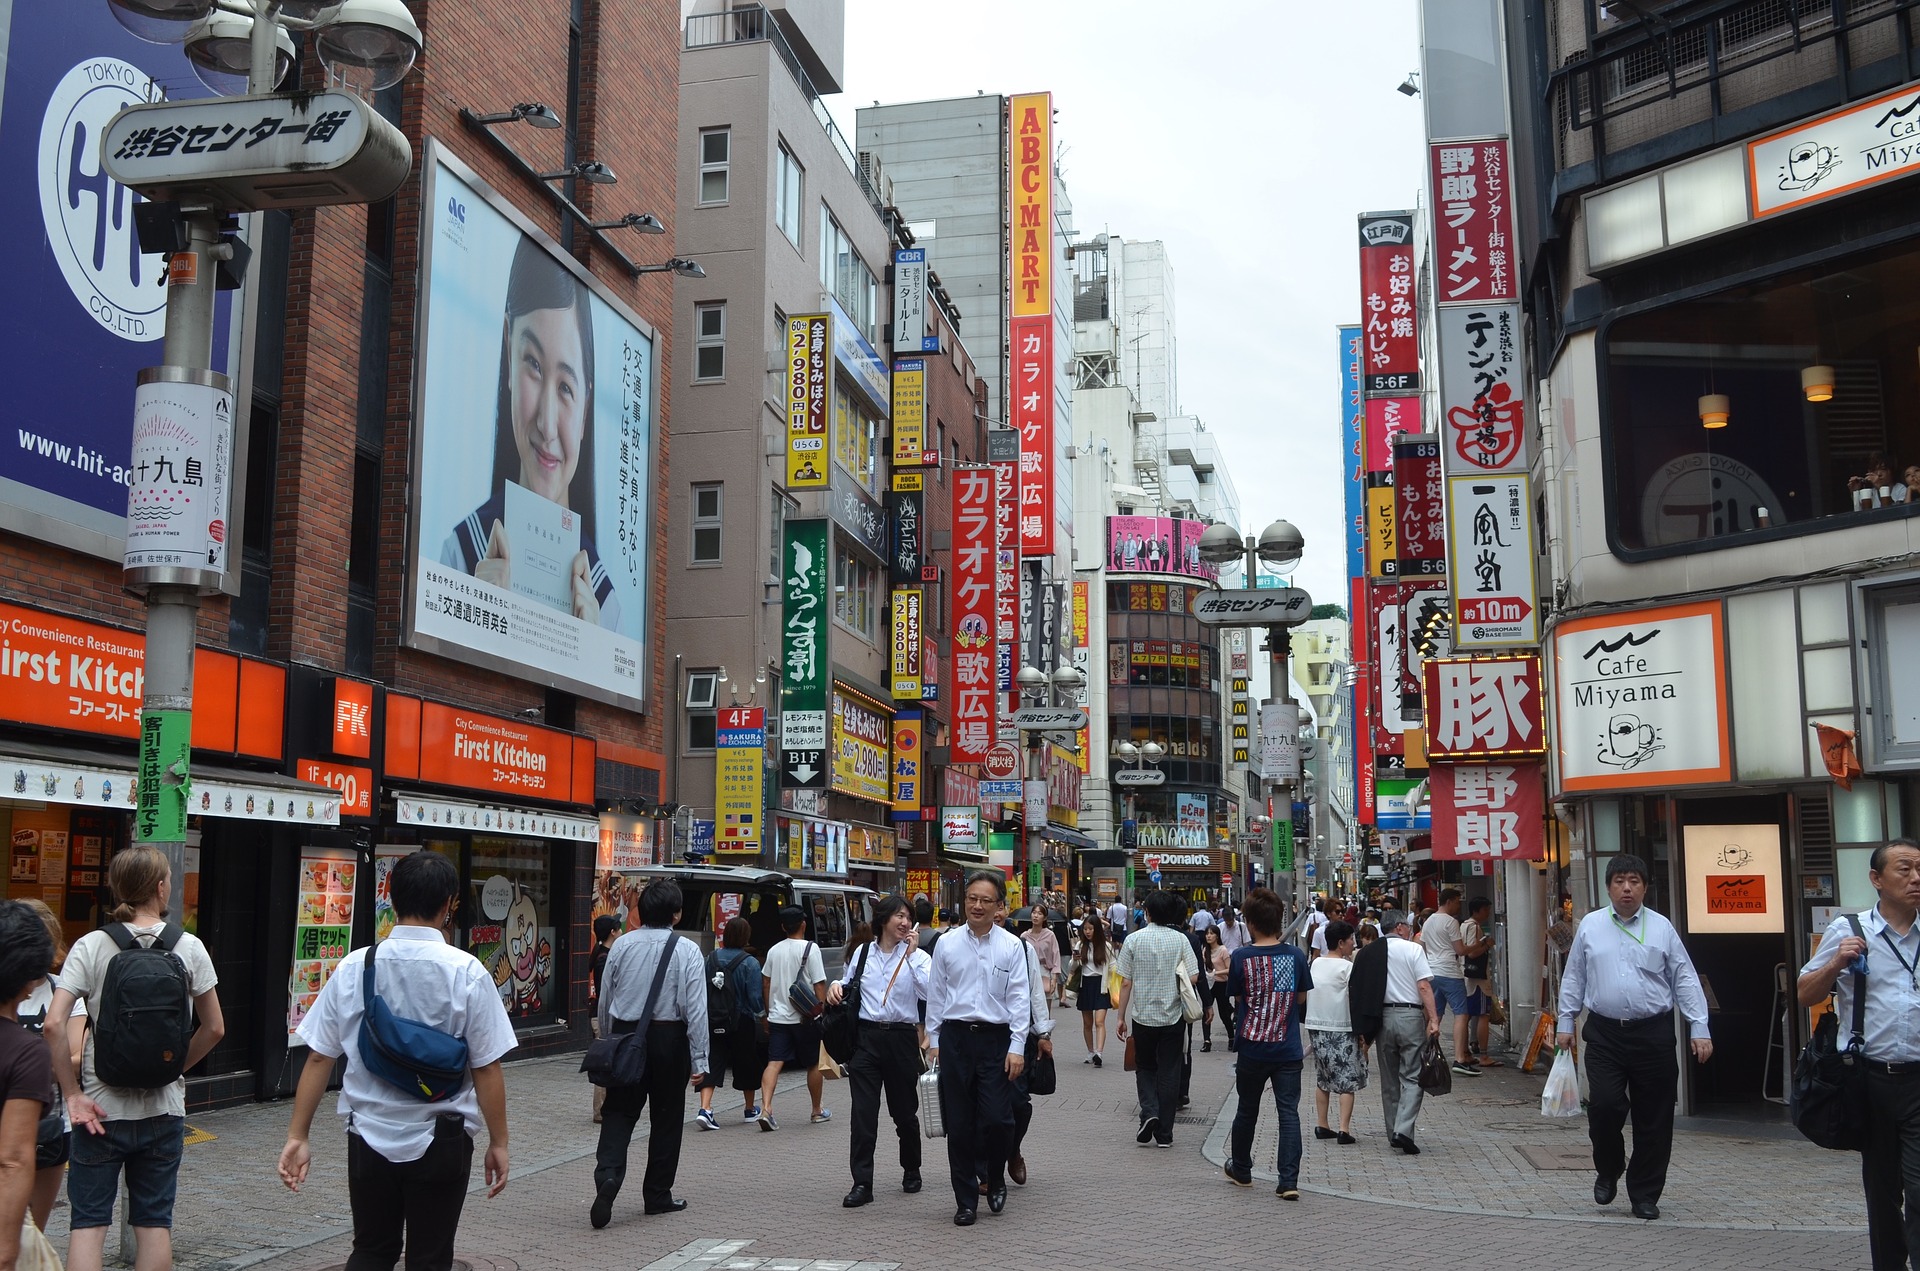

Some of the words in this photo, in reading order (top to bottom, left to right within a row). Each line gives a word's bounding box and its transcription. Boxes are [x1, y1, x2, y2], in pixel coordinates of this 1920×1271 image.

[84, 62, 135, 86] TOKYO
[114, 109, 352, 160] 渋谷センター街
[1020, 107, 1042, 303] ABC-MART
[1367, 225, 1404, 239] 江戸前
[1439, 147, 1480, 298] 野郎ラーメン
[173, 259, 192, 272] JBL
[898, 252, 921, 262] CBR
[899, 267, 911, 342] モニタールーム
[912, 267, 920, 316] 渋谷センター街
[1389, 254, 1413, 338] お好み焼
[791, 320, 807, 332] 60分
[1367, 293, 1391, 368] もんじゃ
[1499, 311, 1513, 362] 東京渋谷
[811, 321, 826, 430] 全身もみほぐし
[617, 339, 632, 557] わたしは進学する。
[794, 439, 820, 449] りらくる
[1021, 333, 1043, 538] カラオケ歌広場
[797, 453, 818, 461] 渋谷店
[923, 453, 936, 461] 4F
[1380, 504, 1393, 550] ピッツァ
[1402, 484, 1424, 557] もんじゃ
[958, 471, 990, 610] カラオケ
[1472, 485, 1511, 592] 一風堂
[147, 554, 182, 563] 佐世保市
[923, 568, 935, 578] 3F
[443, 596, 508, 636] 交通遺児育英会
[1200, 597, 1305, 613] 渋谷センター街
[1464, 600, 1521, 621] 約10m
[12, 619, 84, 648] Convenience
[87, 635, 145, 660] Restaurant
[908, 595, 918, 674] 全身もみほぐし
[1597, 655, 1648, 676] Cafe
[922, 687, 936, 697] 2F
[956, 652, 990, 755] 歌広場
[1437, 661, 1533, 751] 豚
[1575, 683, 1677, 709] Miyama
[69, 695, 131, 723] ファースト
[337, 700, 369, 737] FK
[729, 710, 751, 726] 4F
[785, 714, 824, 722] レモンステーキ
[843, 702, 887, 745] 全身もみほぐし
[1017, 714, 1081, 722] 渋谷センター街
[455, 718, 468, 731] City
[468, 720, 500, 736] Convenience
[502, 727, 528, 742] Restaurant
[785, 725, 823, 733] ねぎ塩焼き
[1263, 733, 1297, 746] 九十九島
[454, 733, 490, 762] First
[493, 740, 547, 772] Kitchen
[789, 752, 820, 764] B1F
[989, 756, 1013, 768] 消火栓
[141, 717, 162, 838] 客引きは犯罪です
[308, 766, 319, 781] 1F
[324, 771, 356, 807] 120
[360, 790, 369, 807] 席
[493, 768, 521, 786] ファースト
[522, 771, 546, 789] キッチン
[896, 757, 917, 801] 松屋
[1454, 766, 1520, 857] 野郎
[1711, 899, 1762, 911] Miyama
[1724, 888, 1749, 897] Cafe
